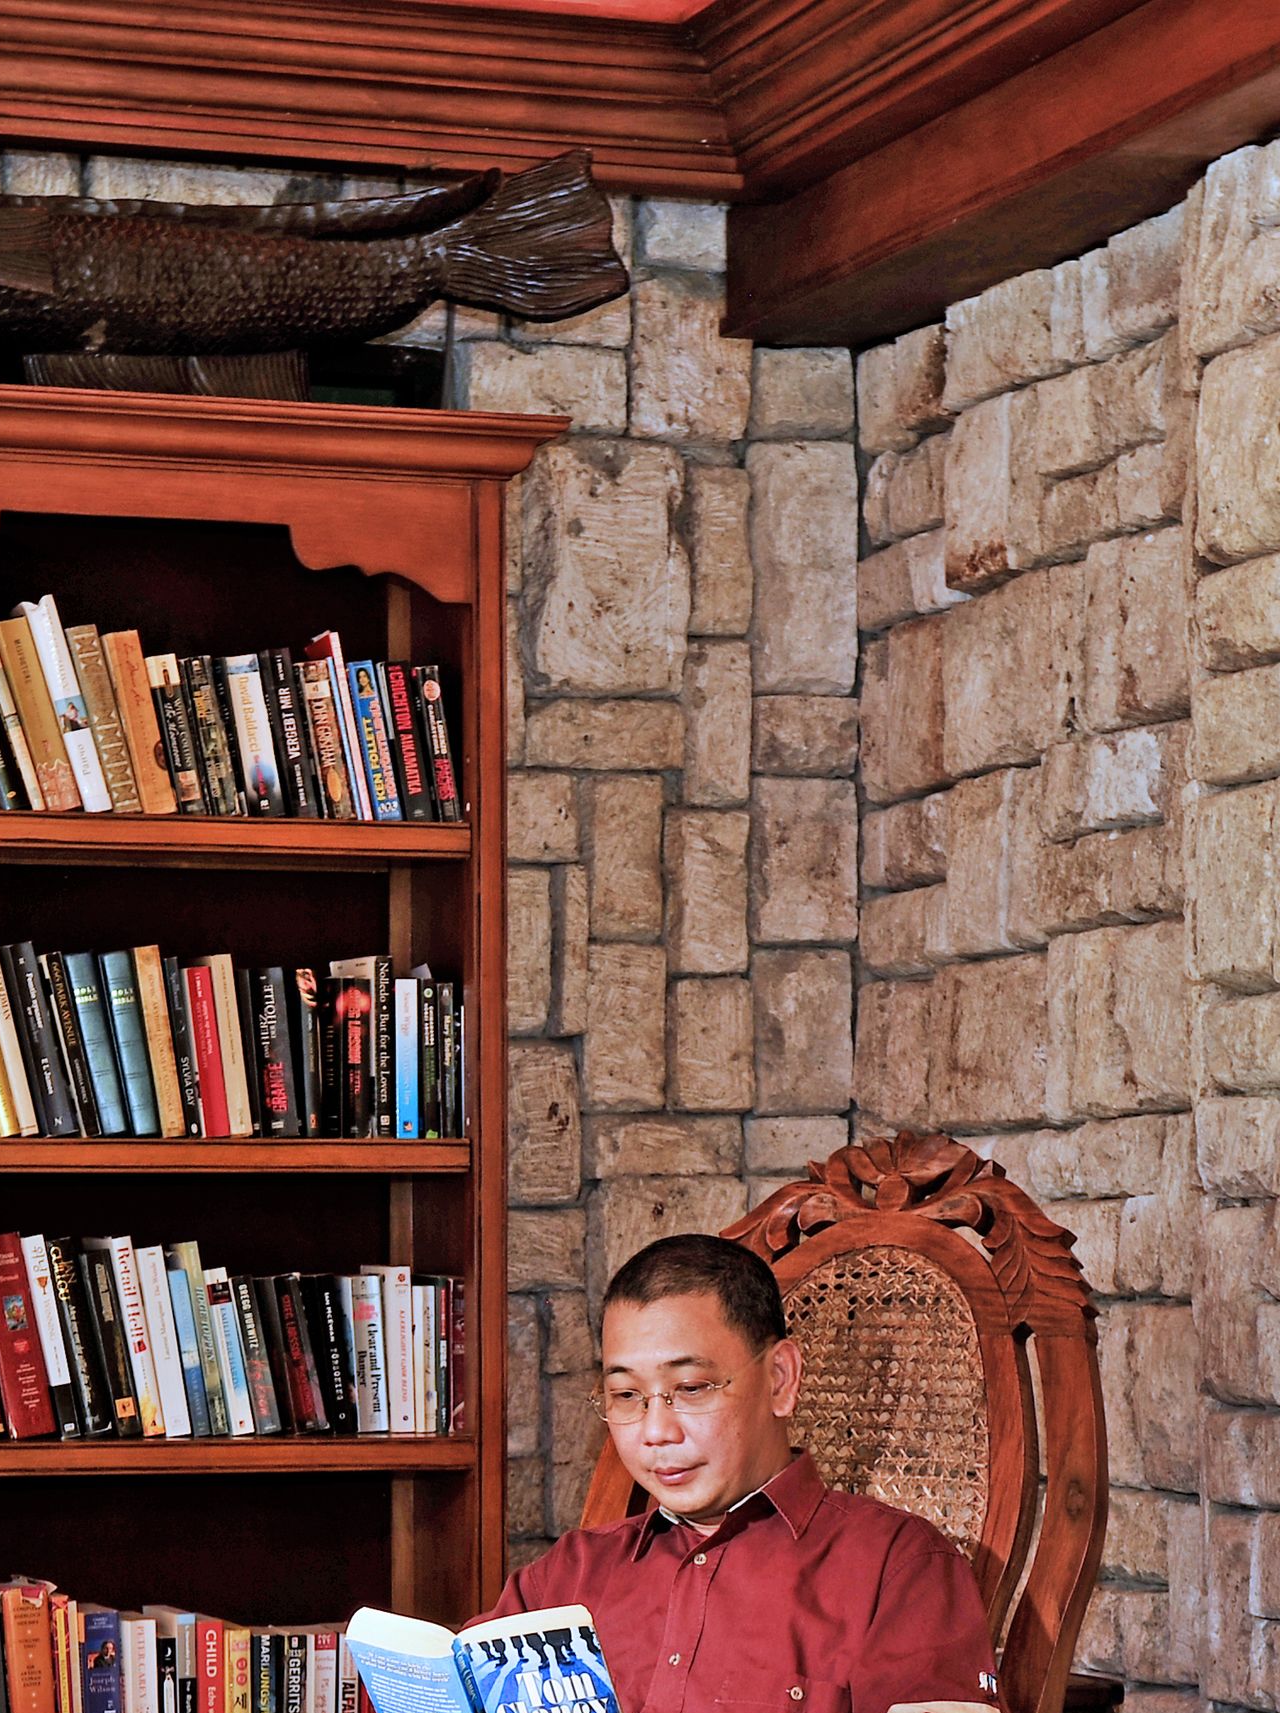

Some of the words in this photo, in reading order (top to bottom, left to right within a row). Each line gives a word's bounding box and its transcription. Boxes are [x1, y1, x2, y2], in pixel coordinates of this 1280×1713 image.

[233, 674, 254, 706] David
[275, 684, 293, 710] MIR
[385, 669, 415, 733] CRICHTON
[309, 697, 330, 726] JOHN
[239, 705, 263, 754] Baldacci
[279, 710, 303, 759] VERGEBT
[315, 724, 339, 768] GRISHAM
[358, 715, 382, 771] FOLLETT
[395, 731, 425, 796] AIKAMATKA
[371, 771, 388, 801] KEN
[53, 981, 69, 1009] PARK
[377, 961, 389, 1003] Nolledo
[59, 1008, 78, 1048] AVENUE
[257, 1013, 271, 1045] HERZ
[377, 1013, 390, 1032] But
[378, 1033, 389, 1050] for
[39, 1057, 48, 1065] E
[178, 1055, 194, 1089] SYLVIA
[378, 1051, 390, 1068] the
[41, 1069, 56, 1096] James
[183, 1087, 197, 1108] DAY
[378, 1069, 390, 1104] Lovers
[60, 1258, 77, 1285] JAN
[116, 1246, 136, 1297] Retail
[237, 1283, 251, 1311] GREGG
[322, 1291, 331, 1306] IAN
[125, 1301, 144, 1338] Hell
[242, 1310, 259, 1350] HURWITZ
[283, 1319, 303, 1361] LARSSON
[365, 1322, 379, 1351] Clear
[355, 1349, 369, 1388] Danger
[368, 1350, 381, 1371] and
[369, 1373, 383, 1413] Present
[135, 1624, 145, 1663] PETER
[204, 1628, 218, 1679] CHILD
[89, 1675, 115, 1687] Joseph
[89, 1685, 116, 1694] Wilson
[136, 1662, 146, 1700] CAREY
[206, 1685, 217, 1708] Echo
[515, 1670, 598, 1709] Tom
